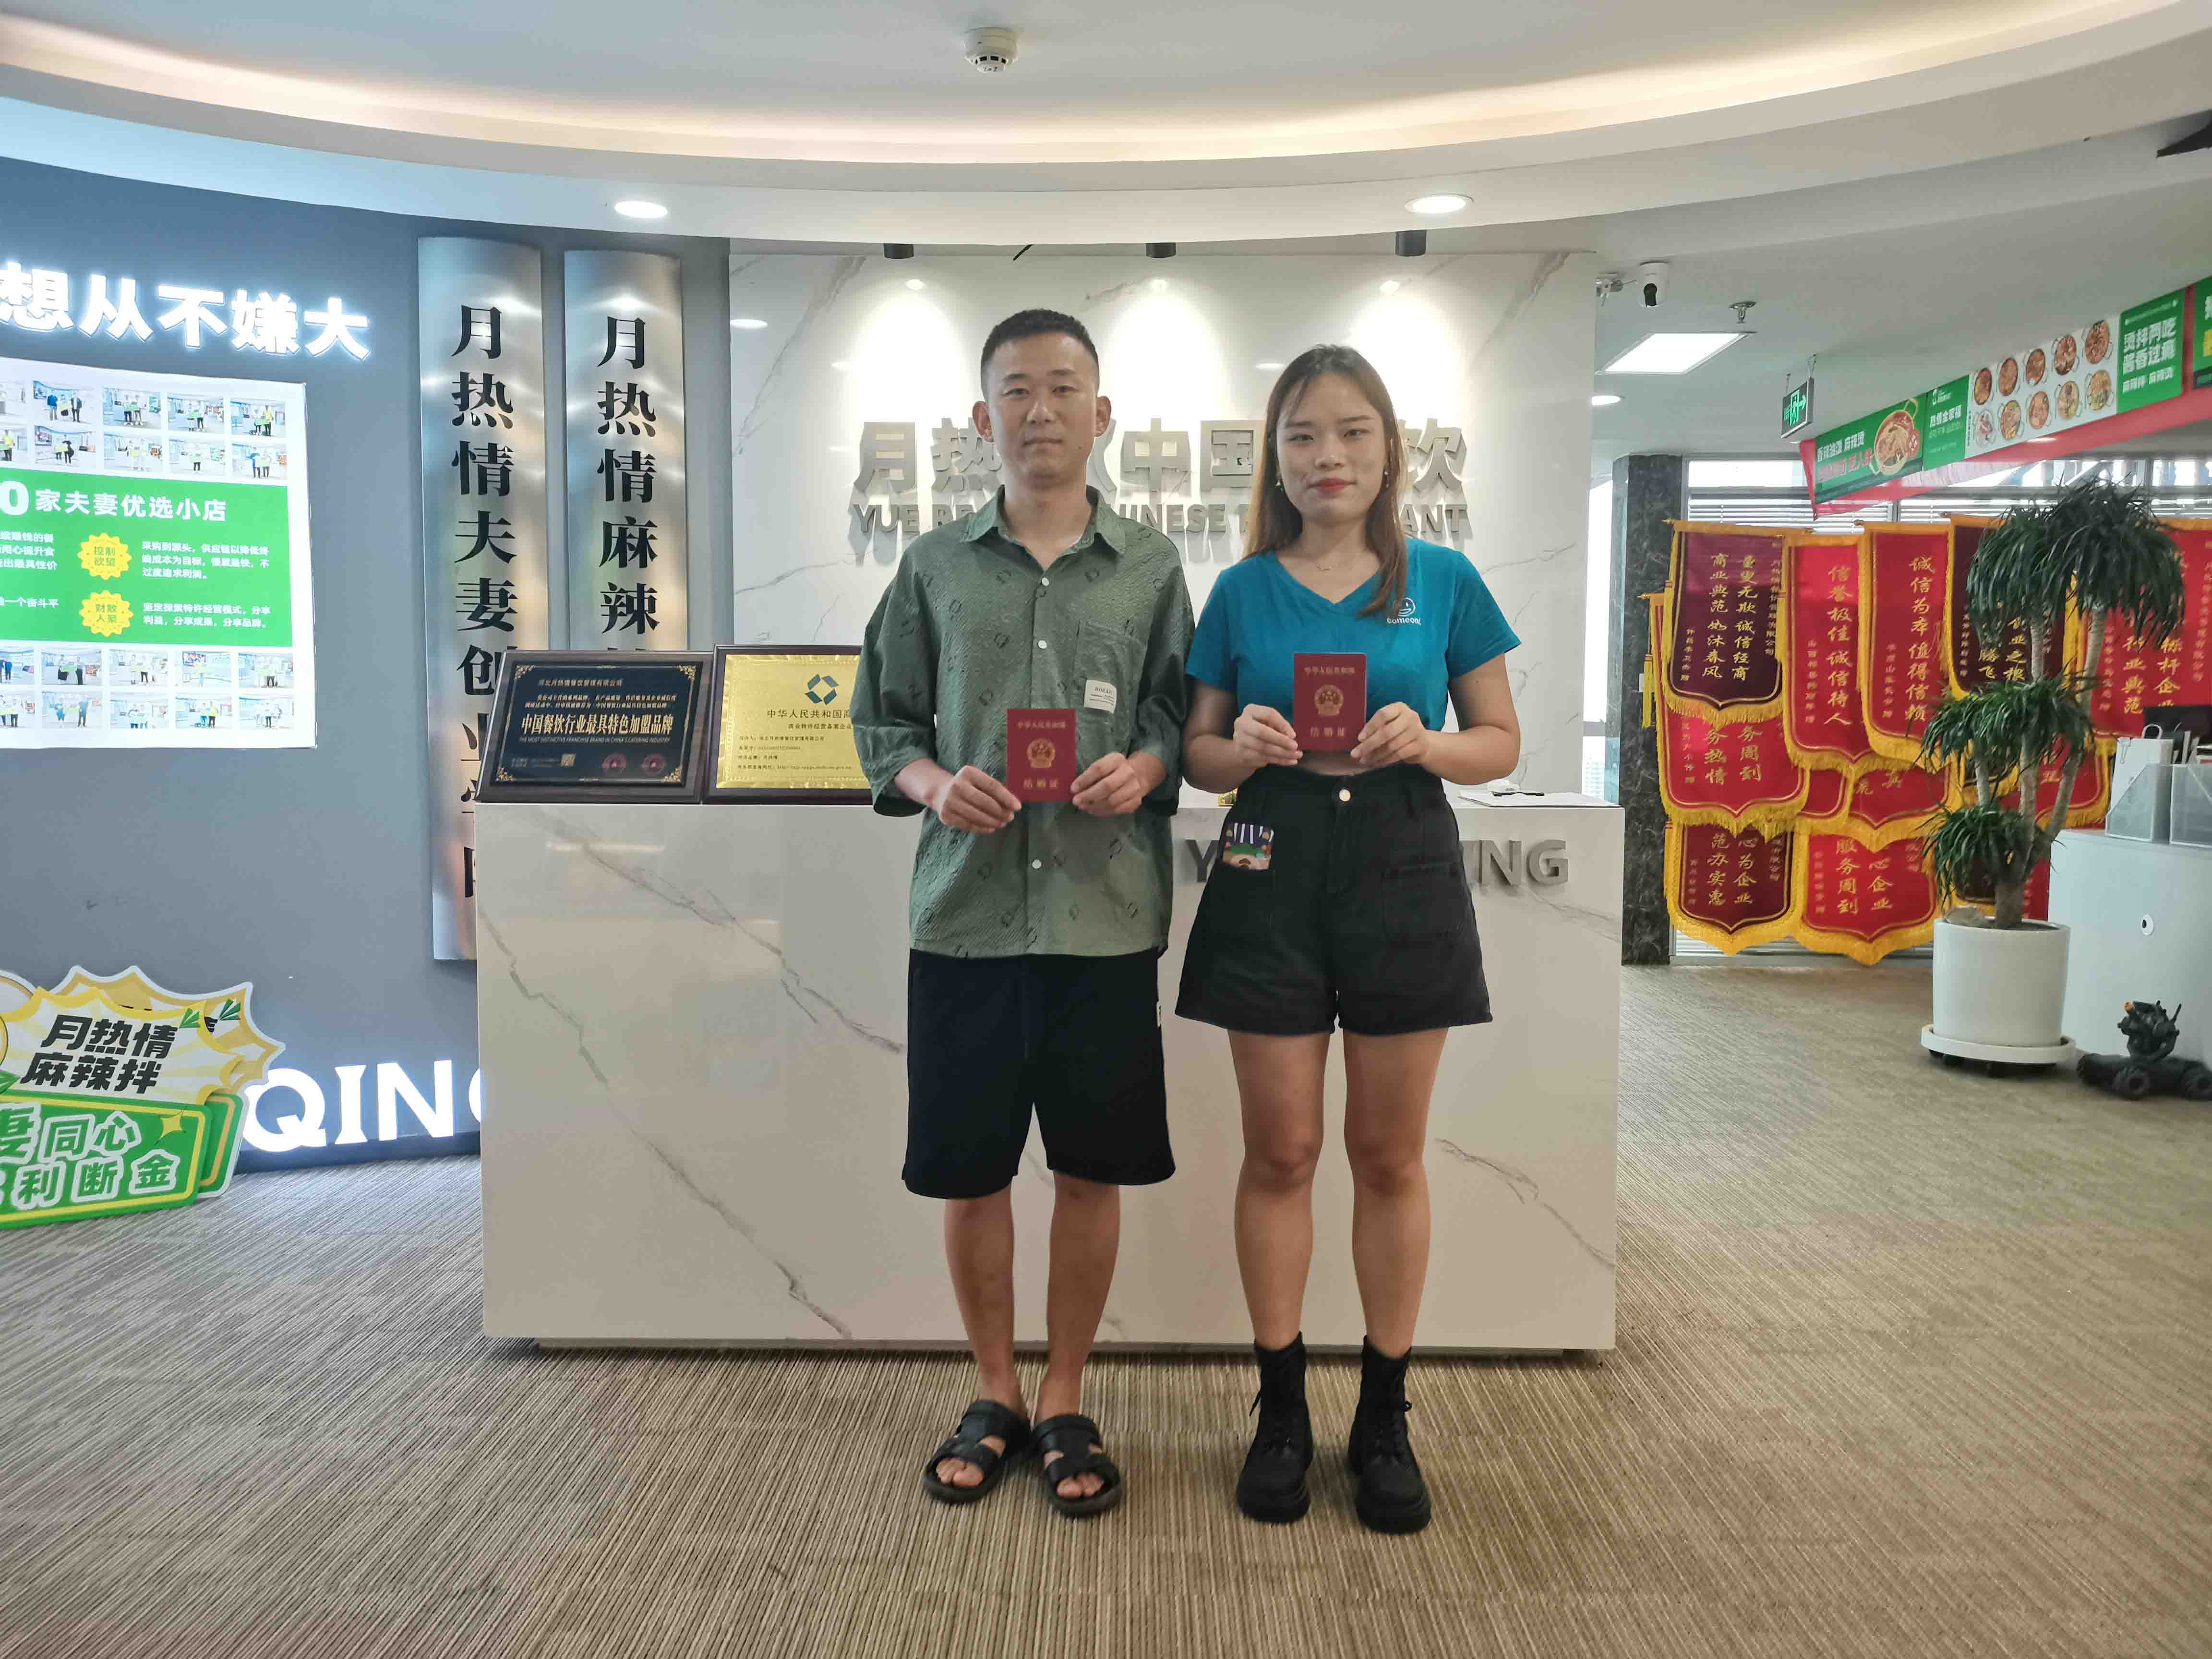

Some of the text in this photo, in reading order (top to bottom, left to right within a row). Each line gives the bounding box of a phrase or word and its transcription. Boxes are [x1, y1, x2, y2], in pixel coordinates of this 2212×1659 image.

[0, 262, 371, 361] 想从不嫌大
[597, 315, 660, 650] 月热情麻辣
[853, 504, 919, 532] YUE
[0, 544, 54, 557] 用心提升食
[0, 558, 58, 570] 出最具性价
[521, 713, 674, 734] 中国餐饮行业最具特色加盟品牌
[40, 1014, 179, 1060] 月热情
[20, 1052, 163, 1094] 麻辣拌
[243, 1059, 481, 1153] QIN
